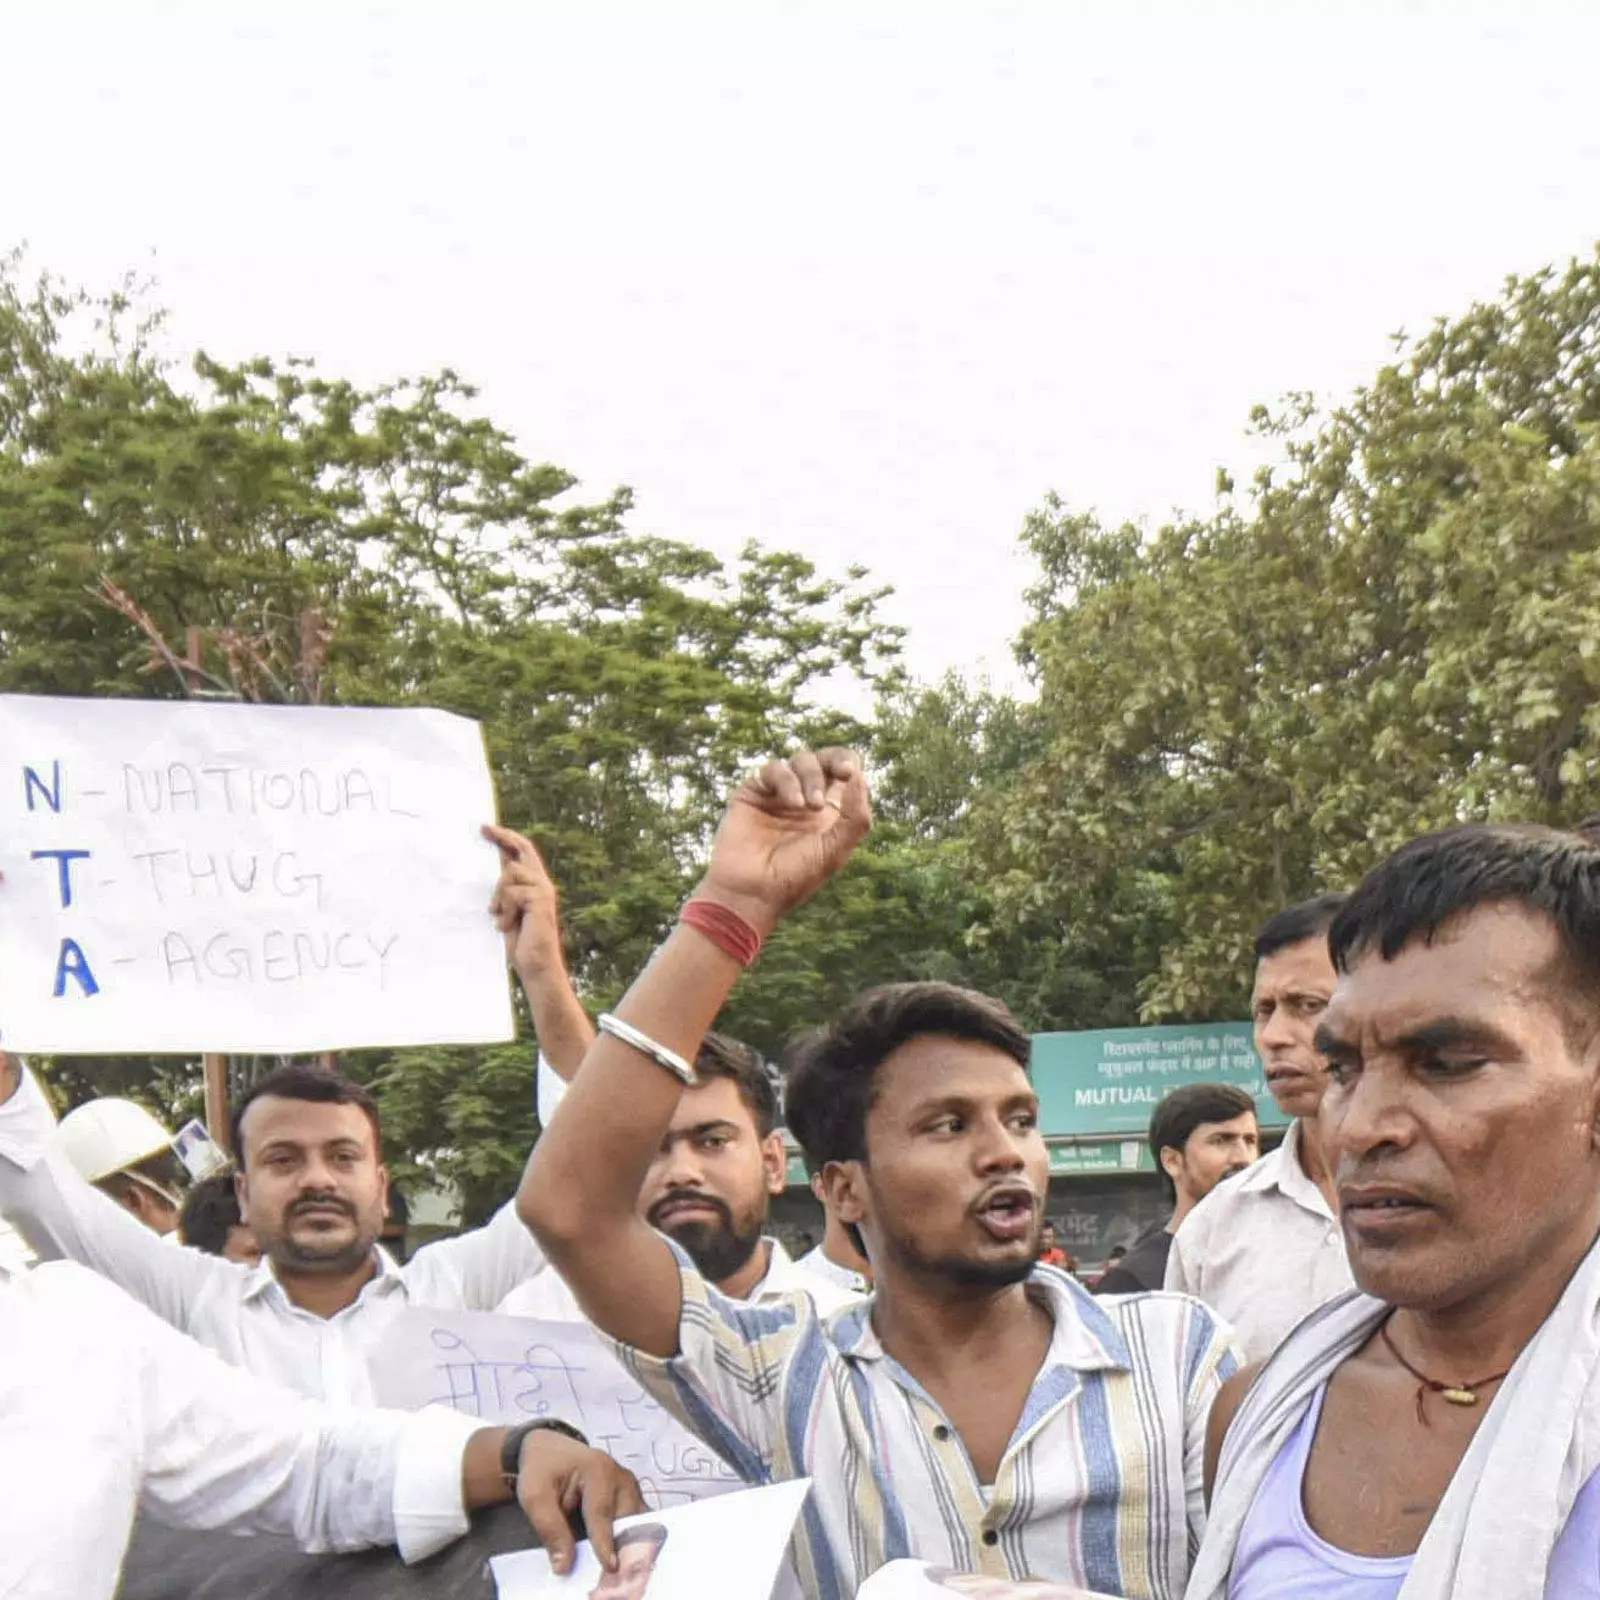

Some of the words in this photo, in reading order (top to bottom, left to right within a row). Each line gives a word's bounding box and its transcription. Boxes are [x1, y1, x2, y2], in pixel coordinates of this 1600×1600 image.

[23, 758, 63, 815] N
[122, 761, 422, 818] NATIONAL
[29, 848, 94, 910] T
[132, 849, 324, 912] THUG
[52, 936, 103, 1000] A
[163, 930, 401, 992] AGENCY
[1074, 1085, 1158, 1107] MUTUAL
